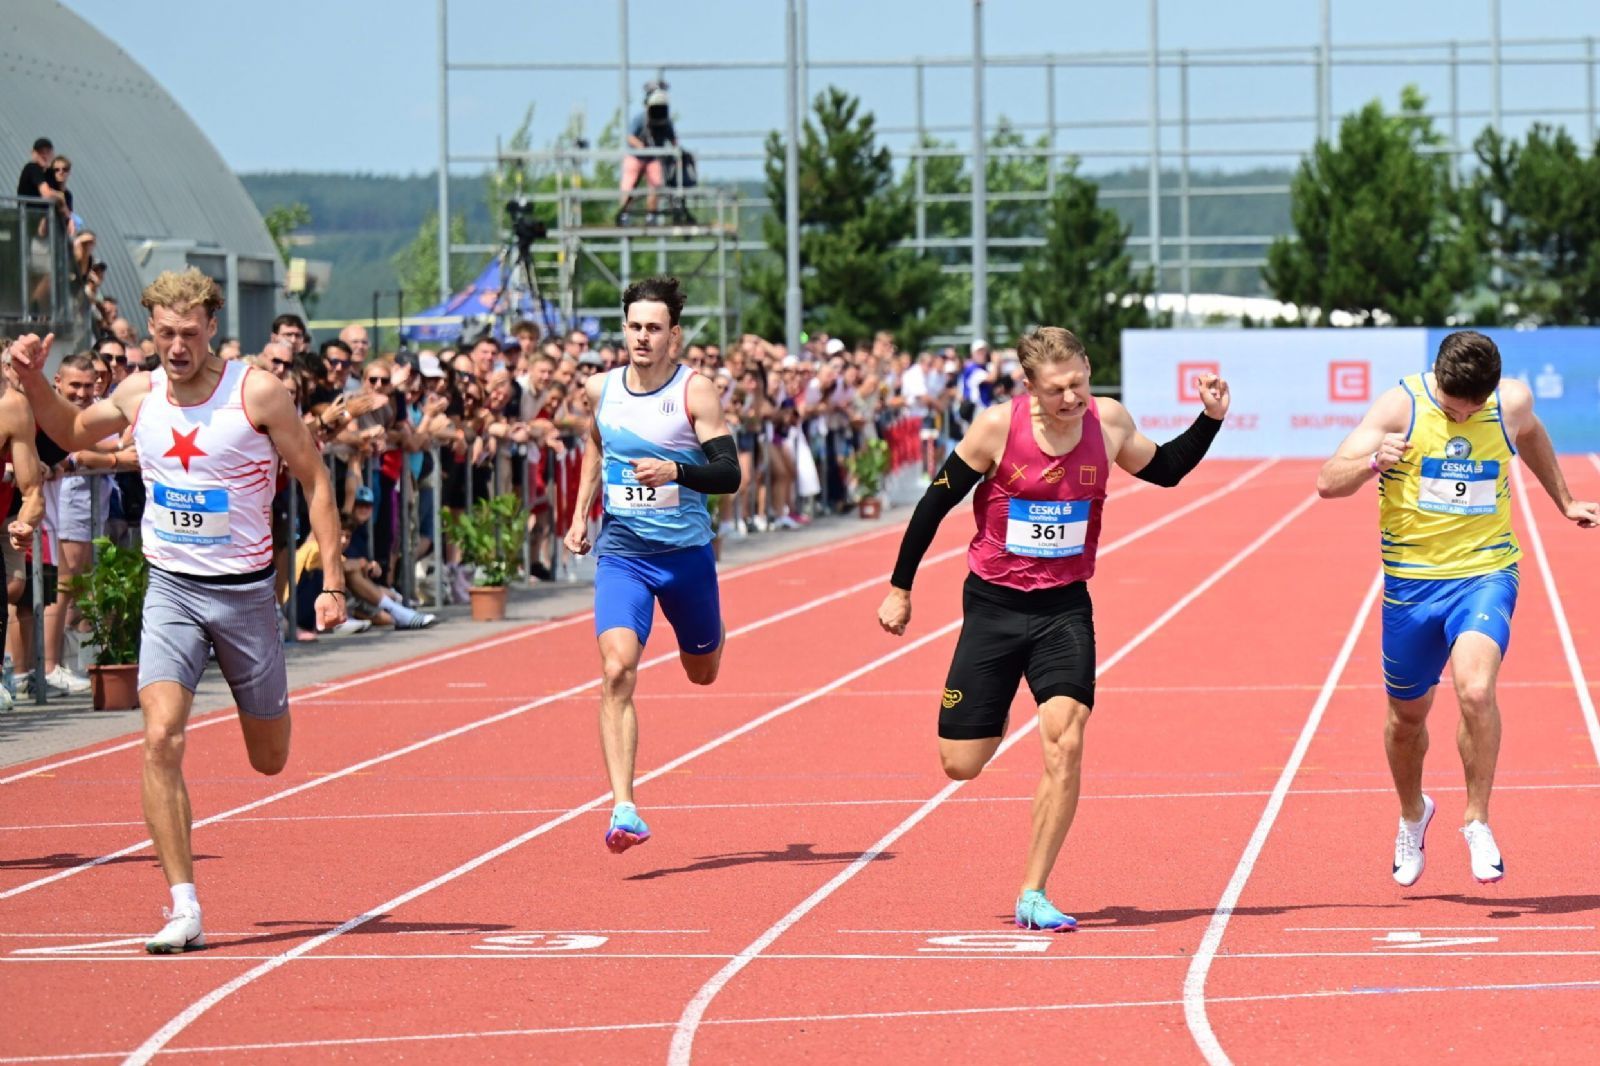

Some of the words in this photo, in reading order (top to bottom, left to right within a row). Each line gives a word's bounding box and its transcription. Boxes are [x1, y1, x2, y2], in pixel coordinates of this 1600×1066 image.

[1441, 461, 1473, 473] ČESKÁ
[166, 489, 194, 503] ČESKÁ
[625, 487, 657, 501] 312
[1455, 481, 1466, 497] 9
[1029, 503, 1061, 515] ČESKÁ
[170, 511, 203, 528] 139
[1031, 523, 1065, 540] 361
